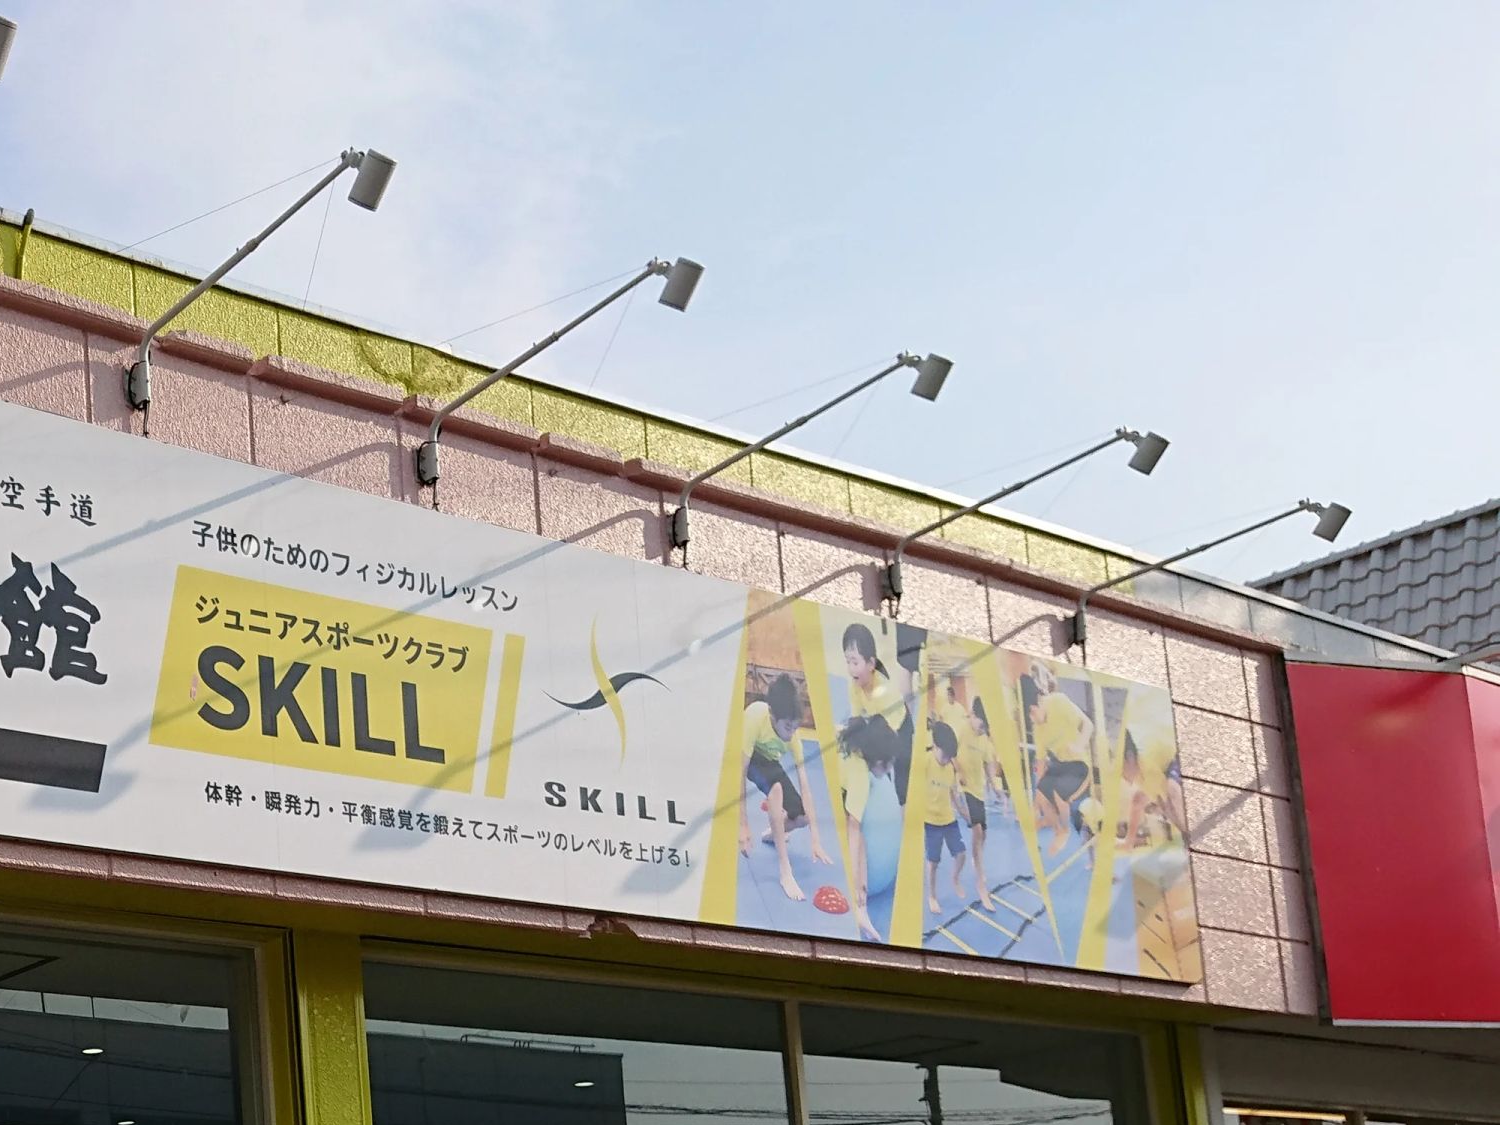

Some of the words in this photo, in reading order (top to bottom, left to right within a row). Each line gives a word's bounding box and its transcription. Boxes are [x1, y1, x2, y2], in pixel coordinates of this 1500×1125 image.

[192, 520, 519, 612] 子供のためのフィジカルレッスン
[195, 595, 470, 673] ジュニアスポーツクラブ
[197, 645, 446, 765] SKILL
[204, 781, 691, 868] 体幹・瞬発力・平衡感覚を鍛えてスポーツのレベルを上げる!
[544, 781, 686, 825] SKILL
